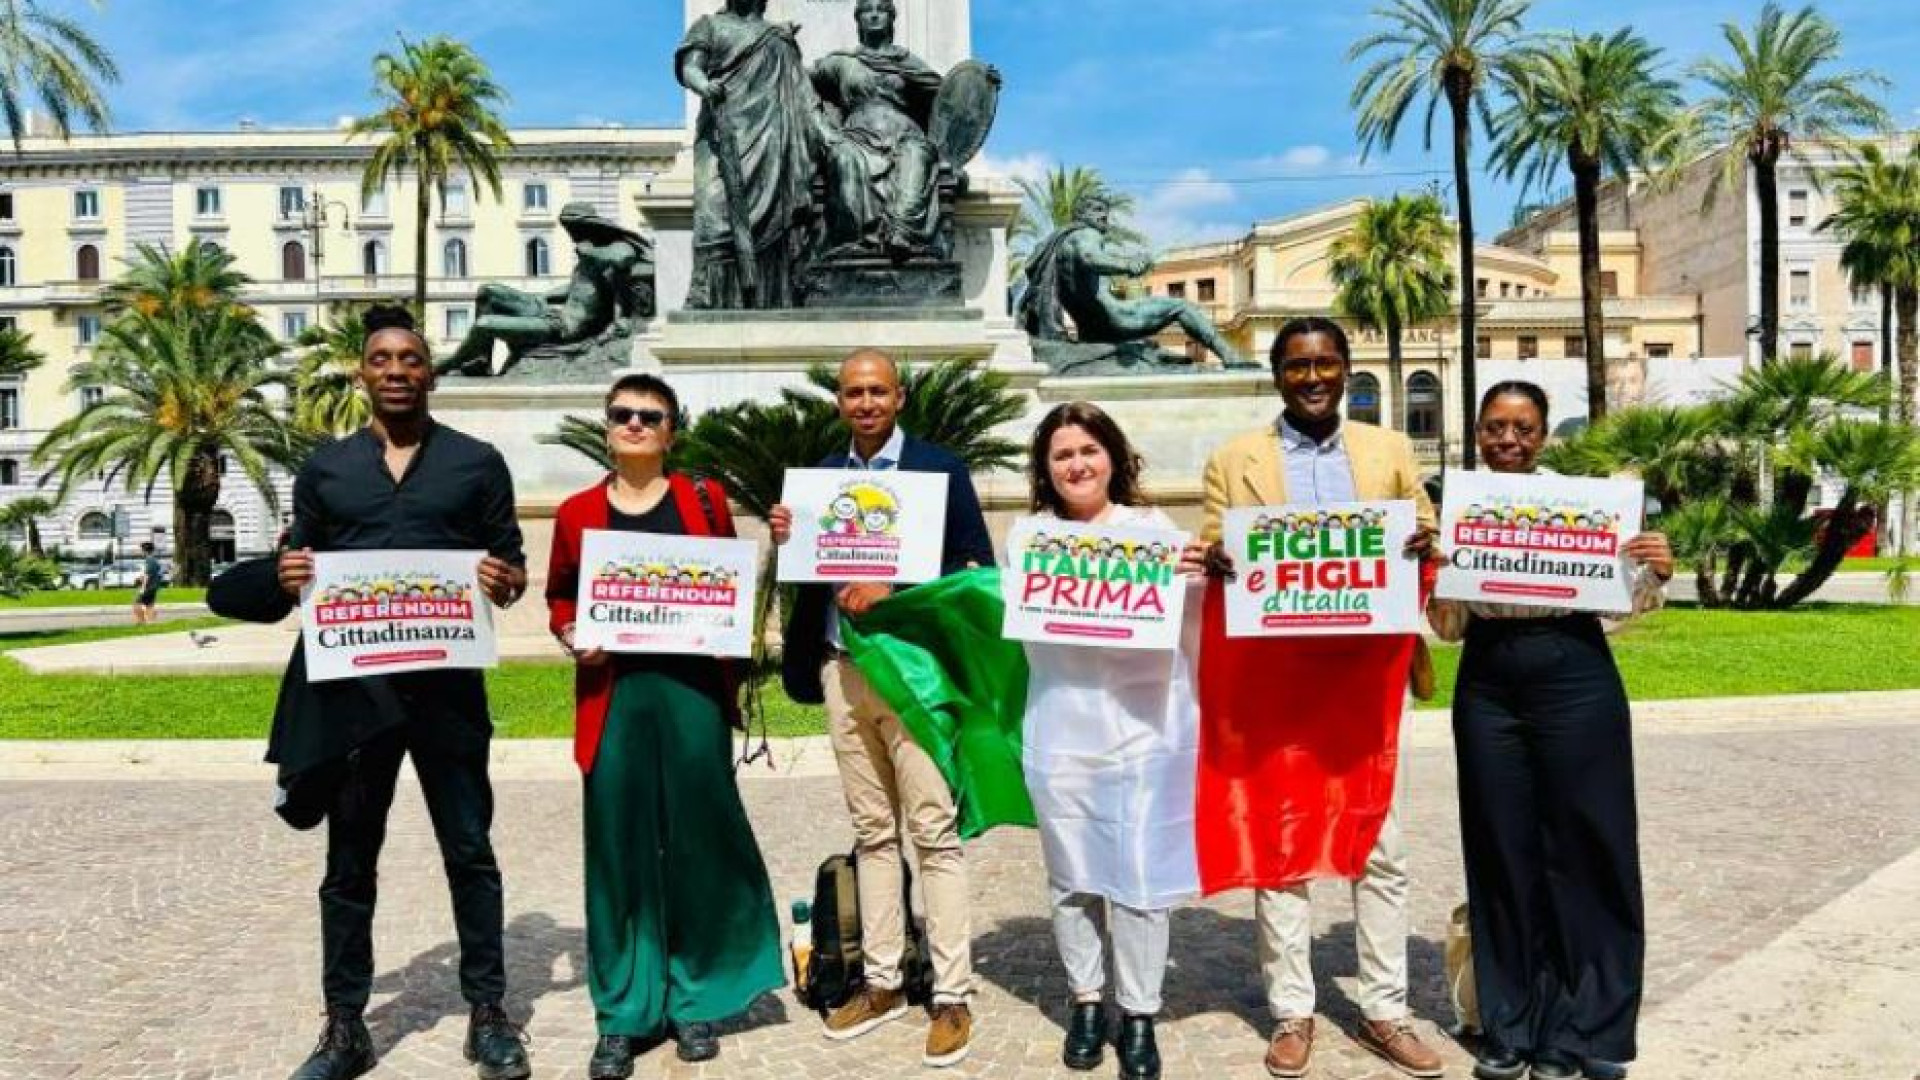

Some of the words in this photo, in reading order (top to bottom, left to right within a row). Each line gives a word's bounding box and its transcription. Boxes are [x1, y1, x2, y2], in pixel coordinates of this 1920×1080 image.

[1247, 527, 1386, 562] FIGLIE
[1458, 524, 1613, 550] REFERENDUM
[1023, 551, 1173, 587] ITALIANI
[1246, 569, 1266, 592] e
[1276, 559, 1388, 592] FIGLI
[1453, 547, 1614, 579] Cittadinanza
[594, 583, 732, 603] REFERENDUM
[1023, 573, 1164, 614] PRIMA
[1263, 586, 1369, 613] d'Italia
[320, 601, 468, 621] REFERENDUM
[318, 622, 476, 649] Cittadinanza
